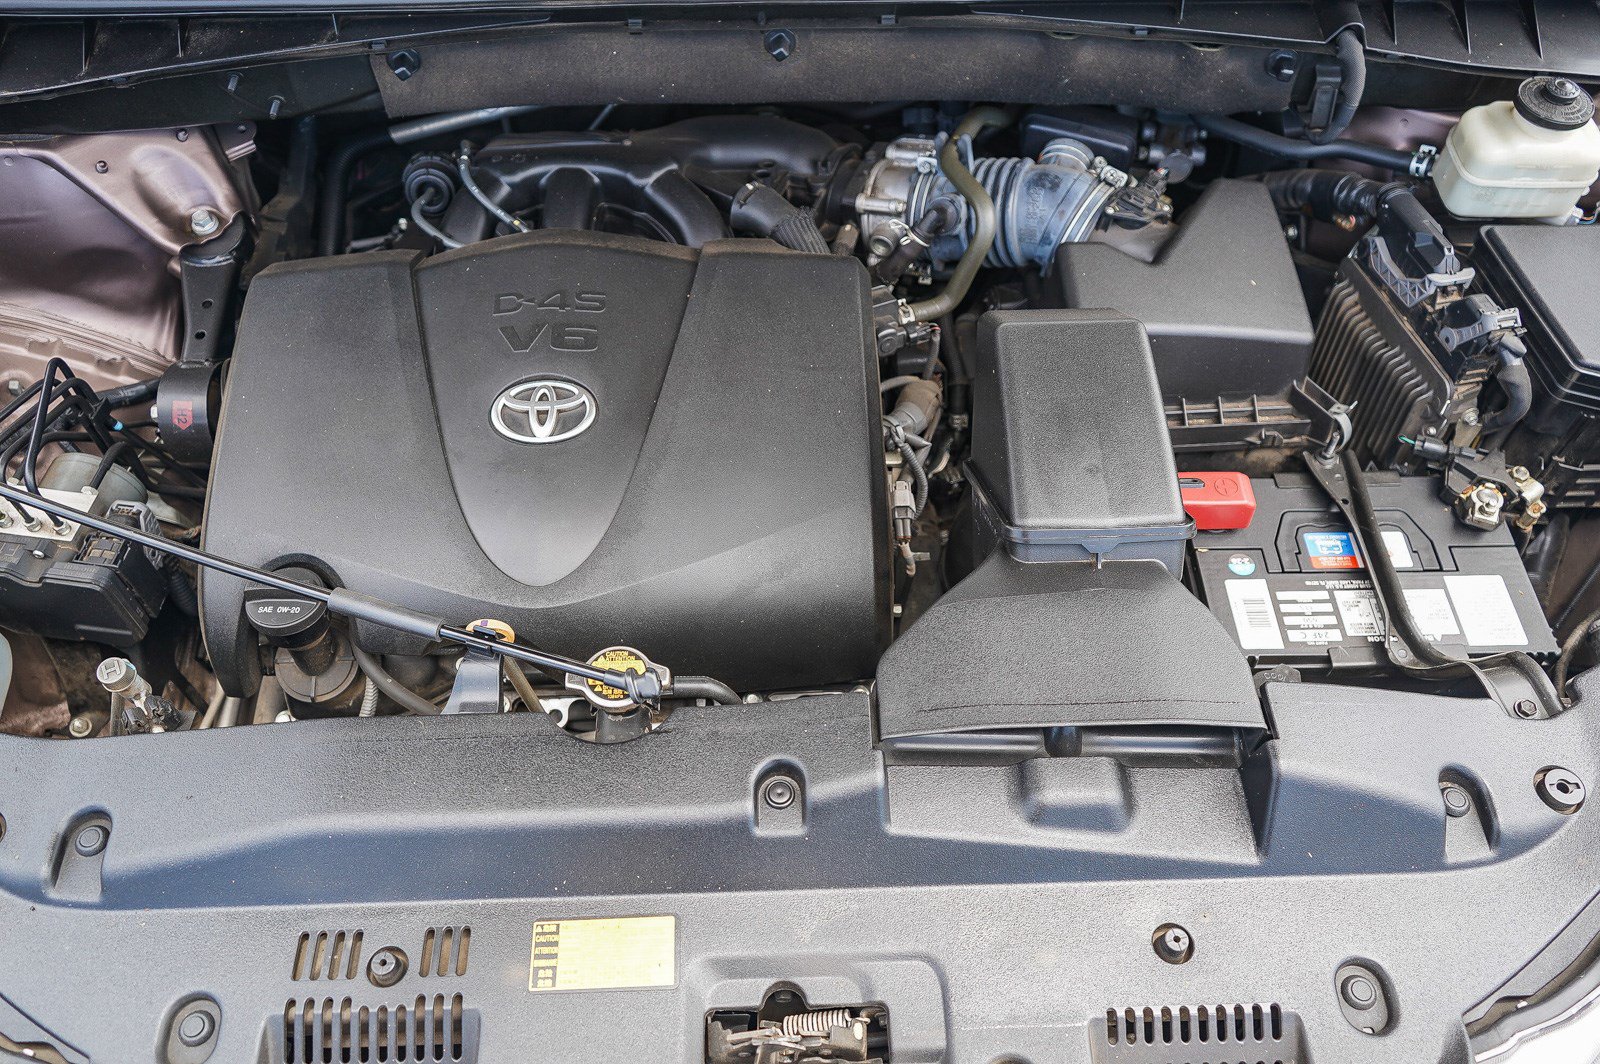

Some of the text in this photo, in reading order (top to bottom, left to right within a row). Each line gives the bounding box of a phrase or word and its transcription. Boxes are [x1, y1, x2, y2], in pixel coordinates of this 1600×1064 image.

[492, 292, 607, 317] D-4S
[497, 323, 599, 353] V6
[257, 606, 301, 614] SAE 0W-20
[101, 659, 121, 681] H
